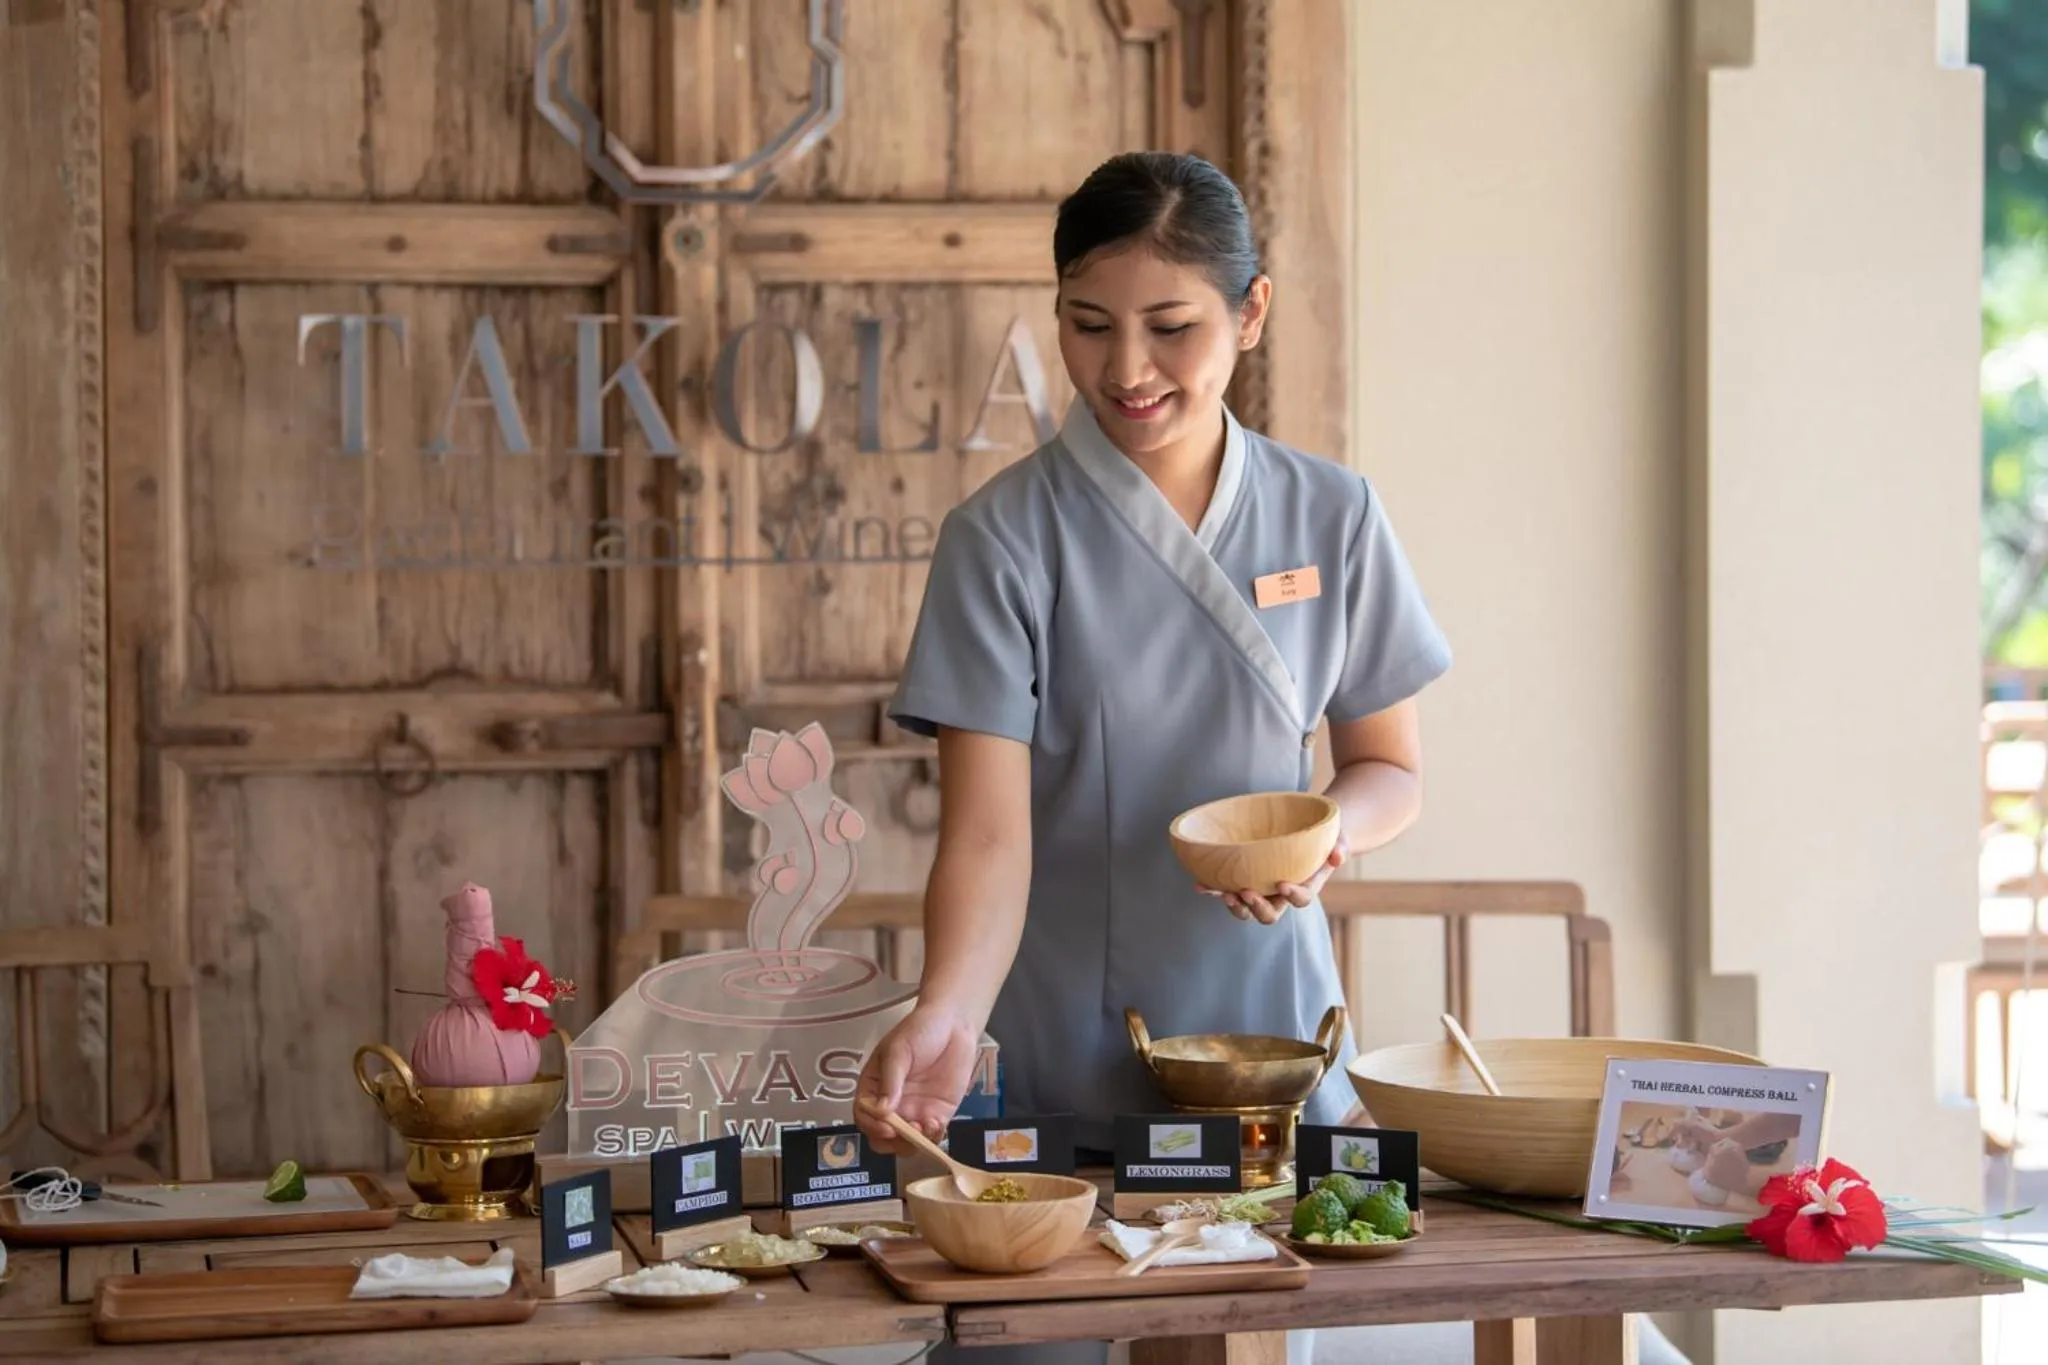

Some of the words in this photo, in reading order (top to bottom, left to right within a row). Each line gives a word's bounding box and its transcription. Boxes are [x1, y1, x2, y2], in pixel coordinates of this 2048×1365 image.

[297, 313, 1057, 457] TAKOLA
[566, 1043, 1001, 1112] DEVASM
[1631, 1079, 1658, 1091] THAI
[1660, 1081, 1705, 1095] HERBAL
[1707, 1085, 1765, 1099] COMPRESS
[1767, 1089, 1798, 1101] BALL
[810, 1173, 869, 1189] GROUND
[1129, 1166, 1231, 1177] LEMONGRASS
[794, 1187, 856, 1205] ROASTED
[859, 1184, 891, 1198] RICE
